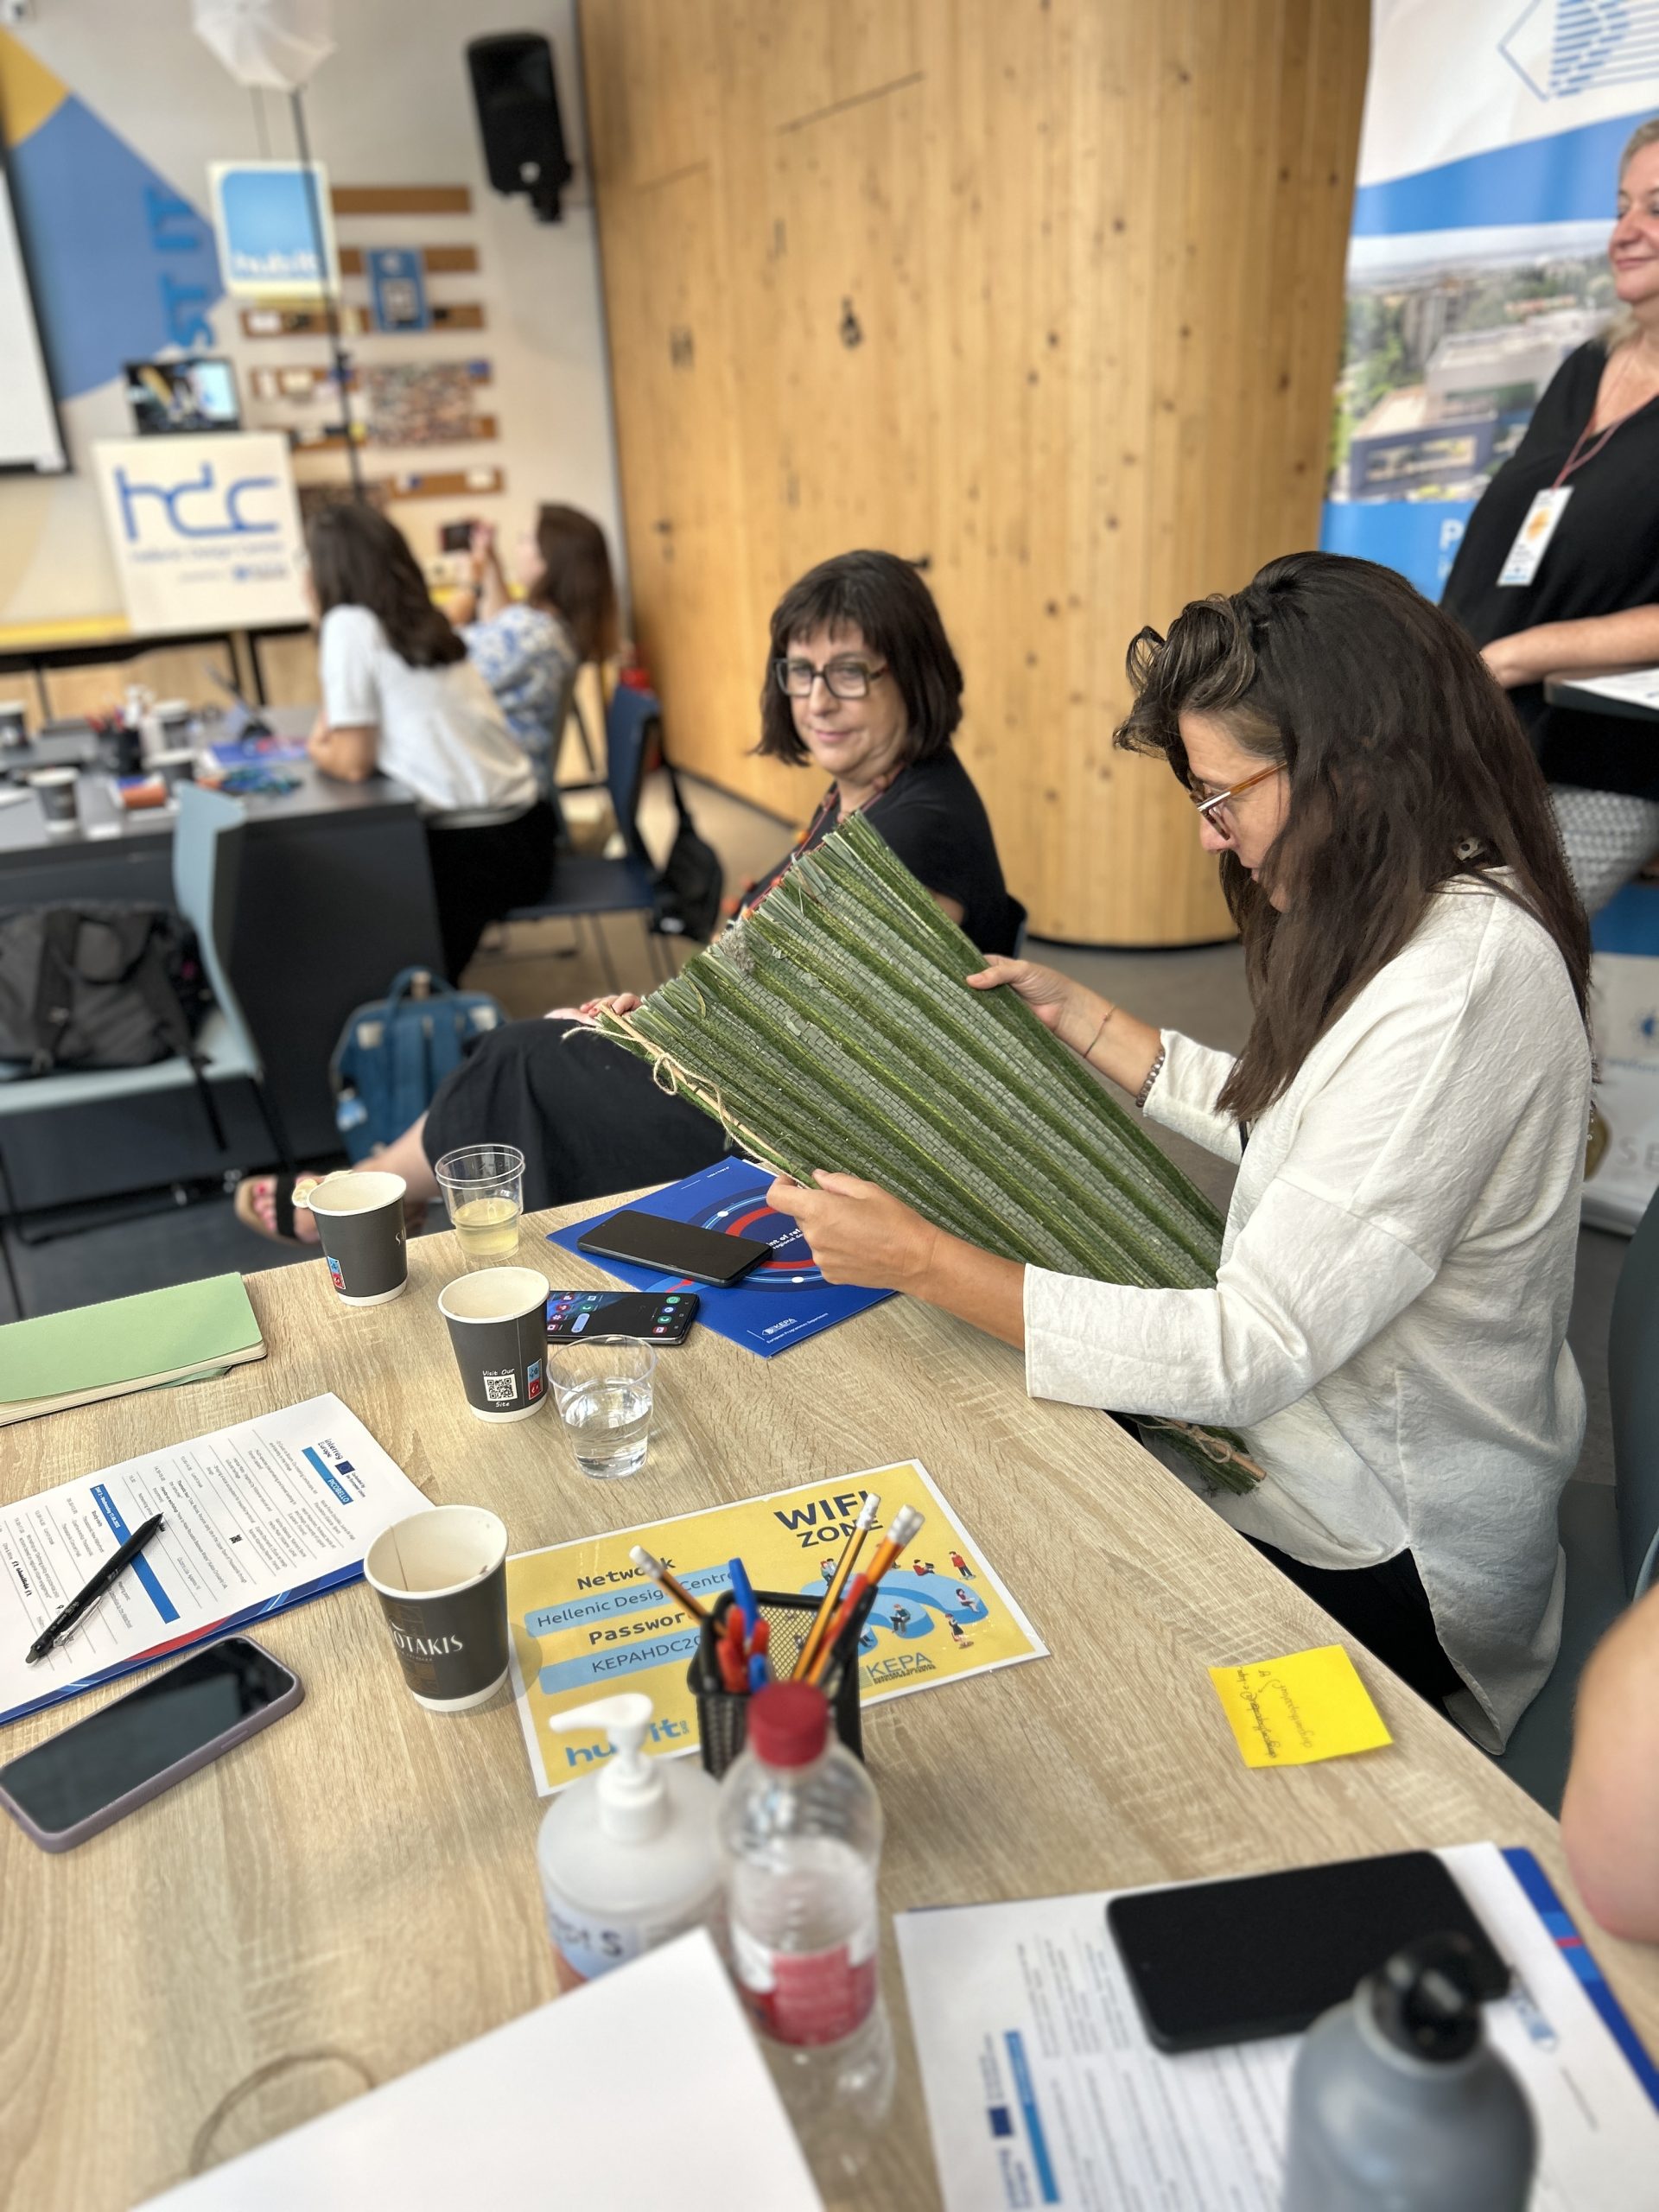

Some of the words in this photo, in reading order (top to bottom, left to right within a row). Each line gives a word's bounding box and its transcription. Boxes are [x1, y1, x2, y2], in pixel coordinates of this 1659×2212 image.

[1439, 518, 1466, 551] P
[317, 1441, 332, 1459] Europe
[322, 1439, 343, 1460] Interreg
[327, 1478, 350, 1503] PICOBELLO
[773, 1490, 869, 1530] WIFI
[577, 1557, 676, 1590] Netwok
[537, 1600, 612, 1628] Hellenic
[614, 1588, 665, 1608] Desig
[392, 1630, 464, 1656] OTAKIS
[588, 1611, 691, 1645] Passwor
[866, 1651, 932, 1678] KEPA
